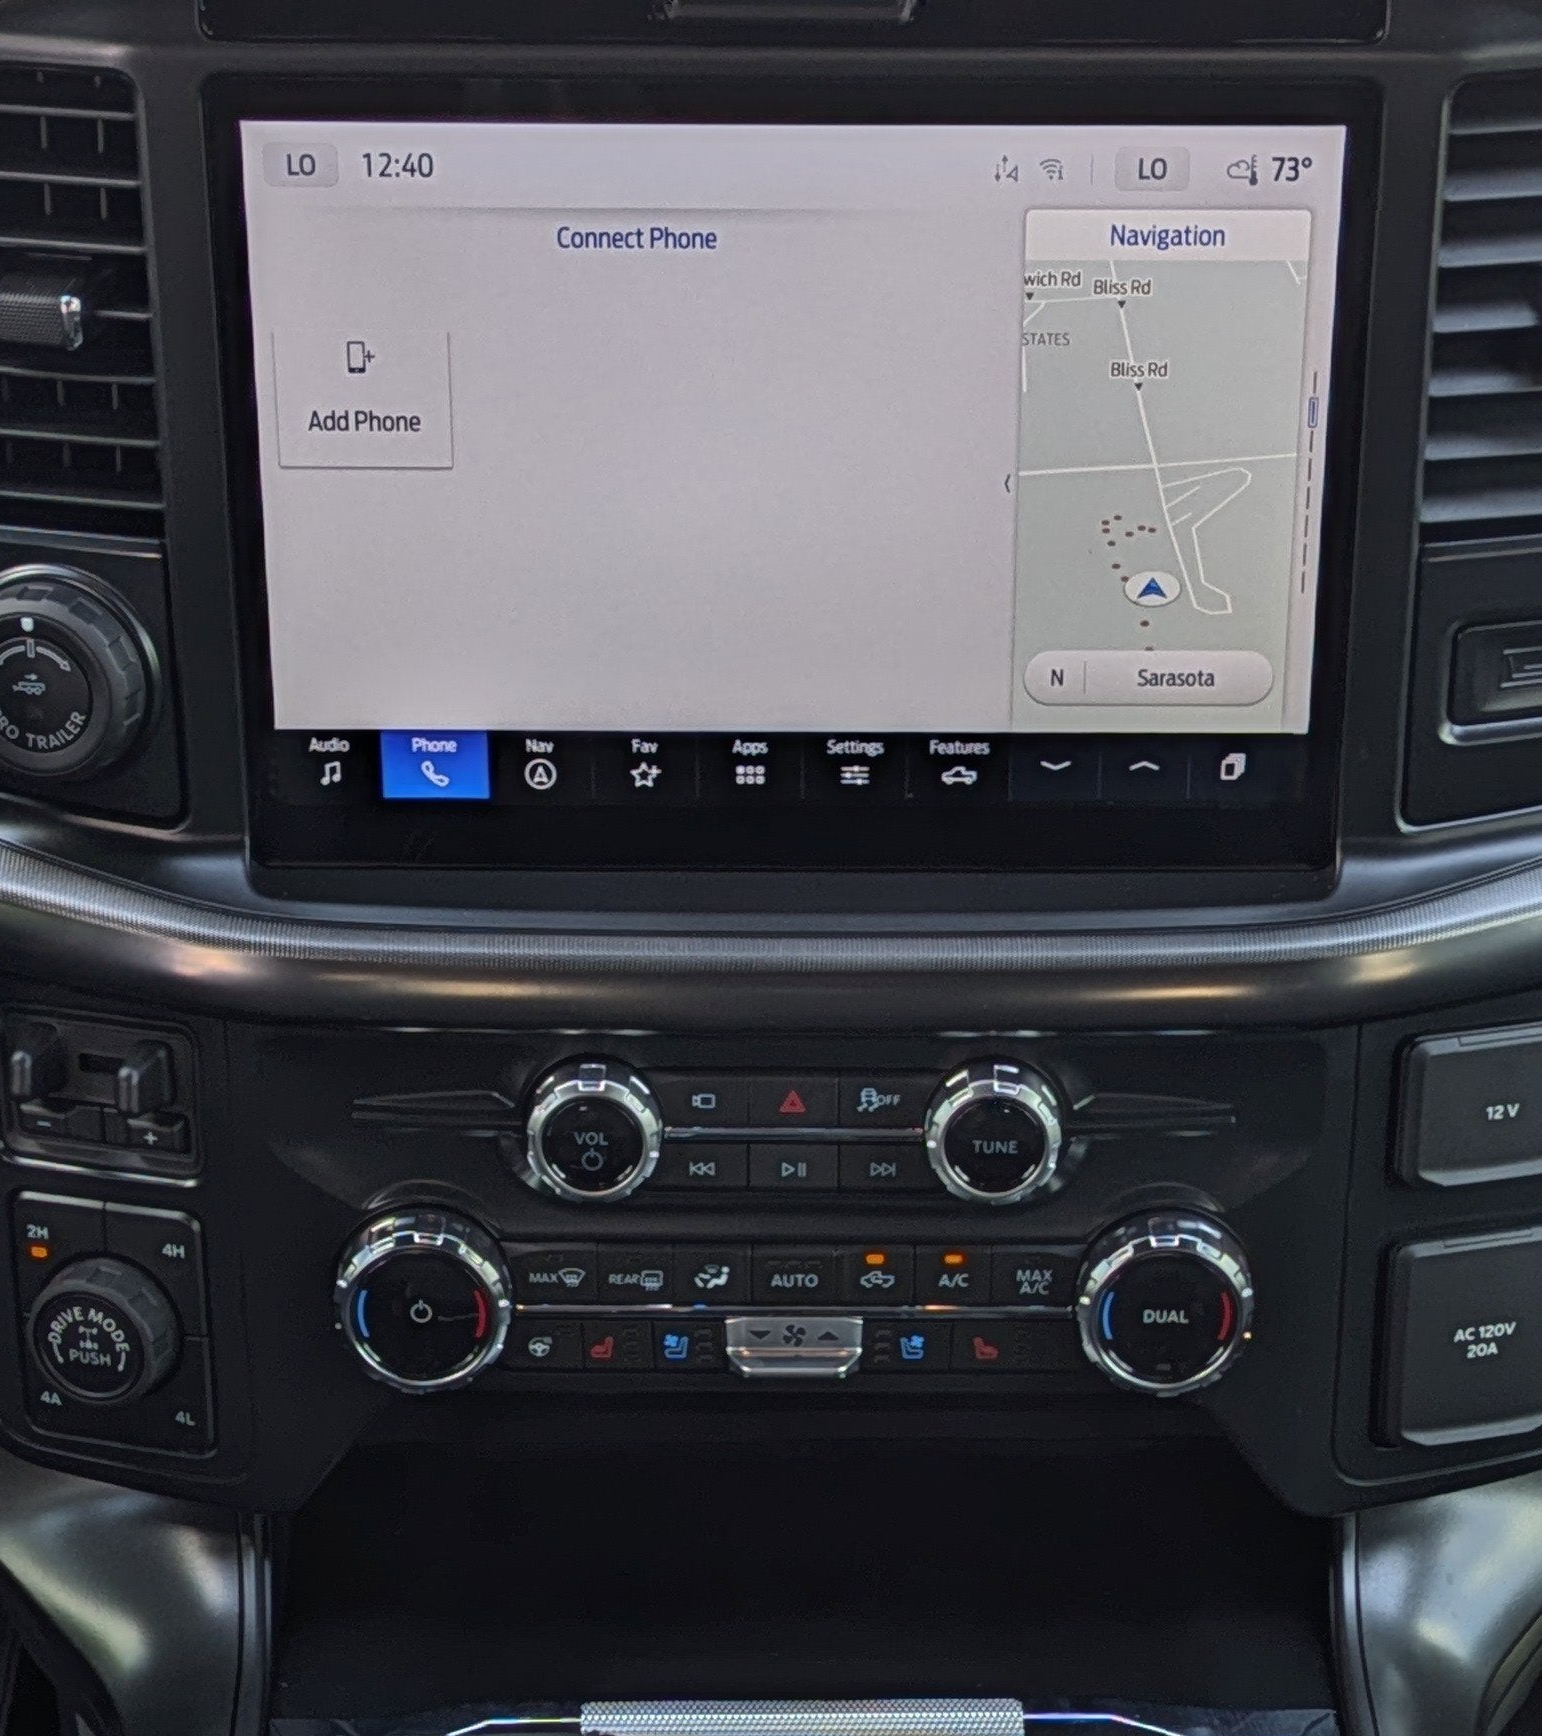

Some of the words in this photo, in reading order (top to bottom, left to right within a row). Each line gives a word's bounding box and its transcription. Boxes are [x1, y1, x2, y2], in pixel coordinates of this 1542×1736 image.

[286, 153, 317, 176] LO
[362, 152, 435, 179] 12:40
[1138, 158, 1167, 180] LO
[557, 227, 644, 250] Connect
[649, 226, 717, 250] Phone
[1110, 224, 1227, 251] Navigation
[1023, 273, 1058, 287] wich
[1062, 271, 1083, 288] Rd
[1092, 280, 1128, 296] Bliss
[1130, 279, 1153, 296] Rd
[1022, 332, 1071, 347] STATES
[1110, 362, 1145, 379] Bliss
[1147, 361, 1169, 379] Rd
[308, 410, 350, 433] Add
[354, 411, 422, 433] Phone
[1050, 668, 1065, 687] N
[1136, 668, 1216, 688] Sarasota
[24, 710, 87, 750] TRAILER
[308, 737, 351, 754] Audio
[411, 737, 458, 754] Phone
[525, 738, 555, 754] Nav
[631, 738, 659, 754] Fav
[731, 738, 769, 757] Apps
[826, 739, 885, 758] Settings
[928, 739, 991, 757] Features
[876, 1092, 901, 1108] OFF
[1486, 1104, 1505, 1121] 12
[1506, 1103, 1520, 1119] V
[573, 1131, 609, 1147] VOL
[972, 1139, 1019, 1155] TUNE
[27, 1223, 49, 1240] 2H
[162, 1243, 186, 1260] 4H
[529, 1272, 558, 1286] MAX
[608, 1272, 639, 1287] REAR
[770, 1272, 819, 1289] AUTO
[938, 1272, 970, 1290] A/C
[1016, 1269, 1053, 1283] MAX
[1019, 1280, 1050, 1297] A/C
[1142, 1309, 1189, 1325] DUAL
[47, 1306, 84, 1344] DRIVE
[88, 1307, 130, 1352] MODE
[1454, 1328, 1475, 1342] AC
[1478, 1322, 1516, 1340] 120V
[69, 1348, 112, 1367] PUSH
[1467, 1343, 1499, 1360] 20A
[40, 1391, 63, 1406] 4A
[175, 1410, 196, 1426] 4L
